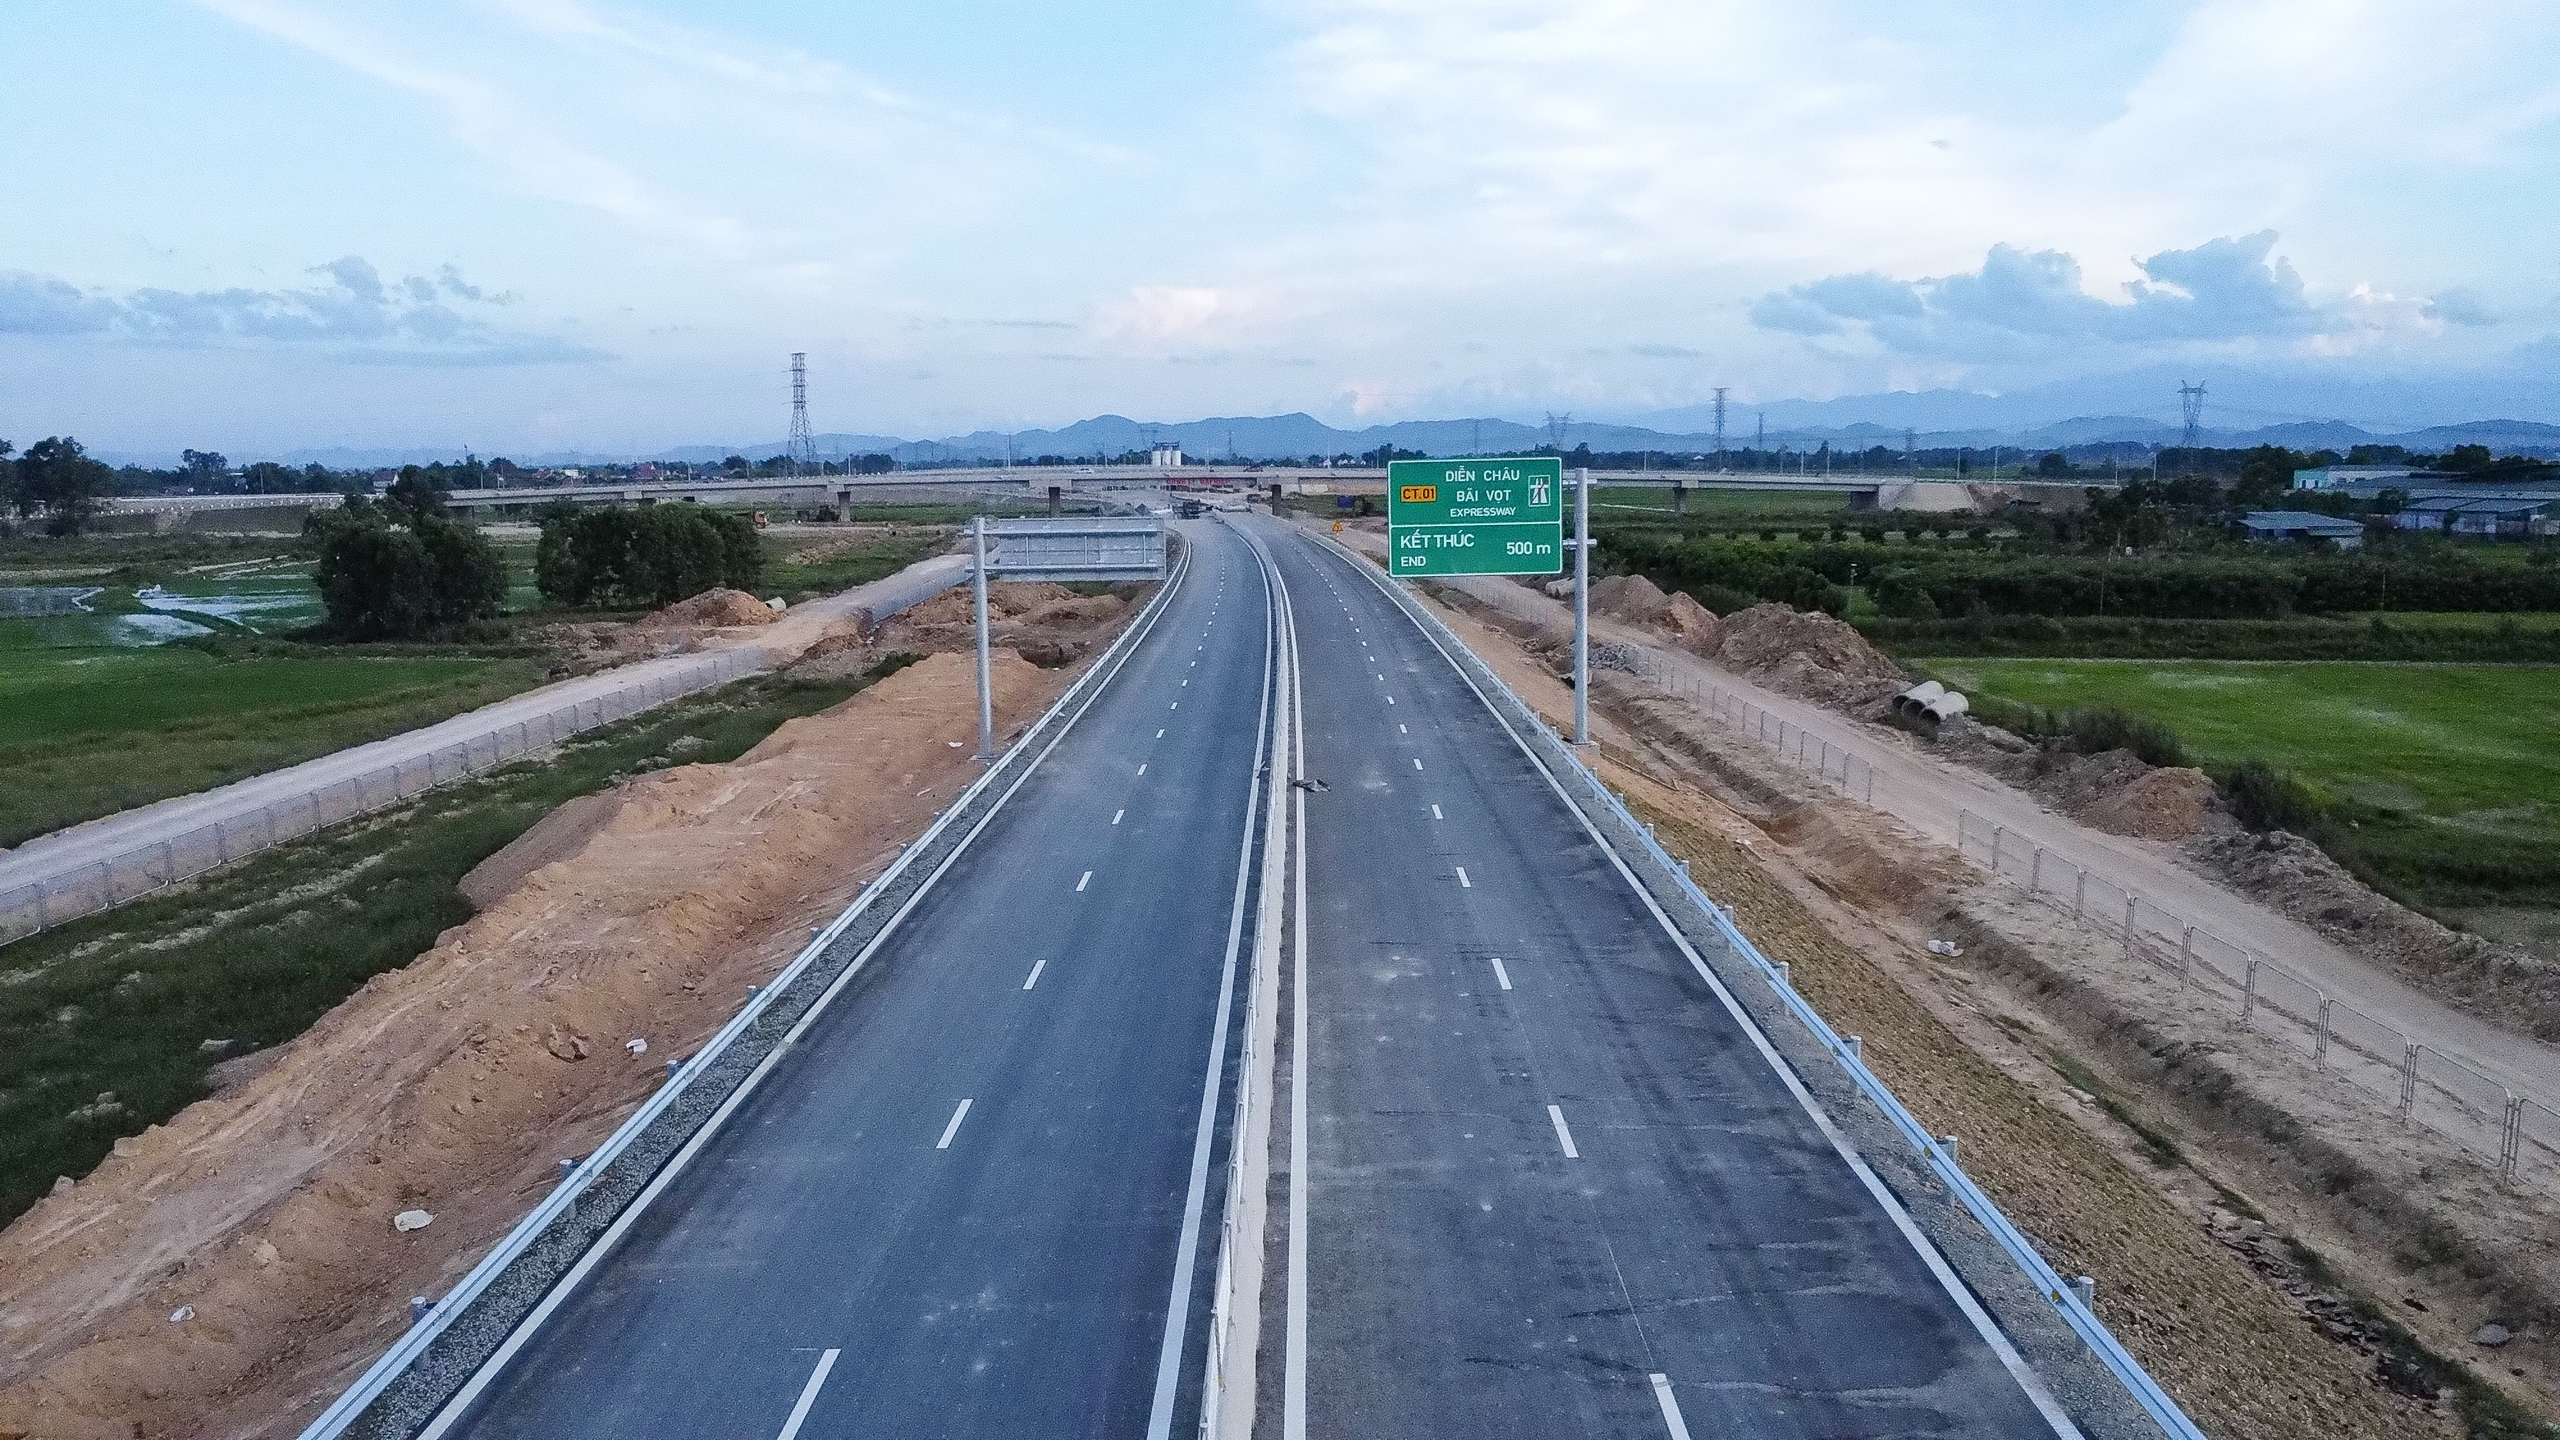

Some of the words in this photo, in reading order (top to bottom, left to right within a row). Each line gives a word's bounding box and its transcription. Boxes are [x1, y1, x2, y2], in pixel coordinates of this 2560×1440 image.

[1445, 465, 1476, 482] DIỄN
[1483, 466, 1520, 481] CHÂU
[1402, 488, 1435, 500] CT.01
[1456, 489, 1478, 502] BÃI
[1485, 489, 1512, 504] VỌT
[1450, 506, 1517, 518] EXPRESSWAY
[1400, 528, 1431, 549] KẾT
[1433, 529, 1475, 548] THÚC
[1506, 542, 1532, 555] 500
[1536, 543, 1551, 555] m
[1401, 556, 1426, 567] END
